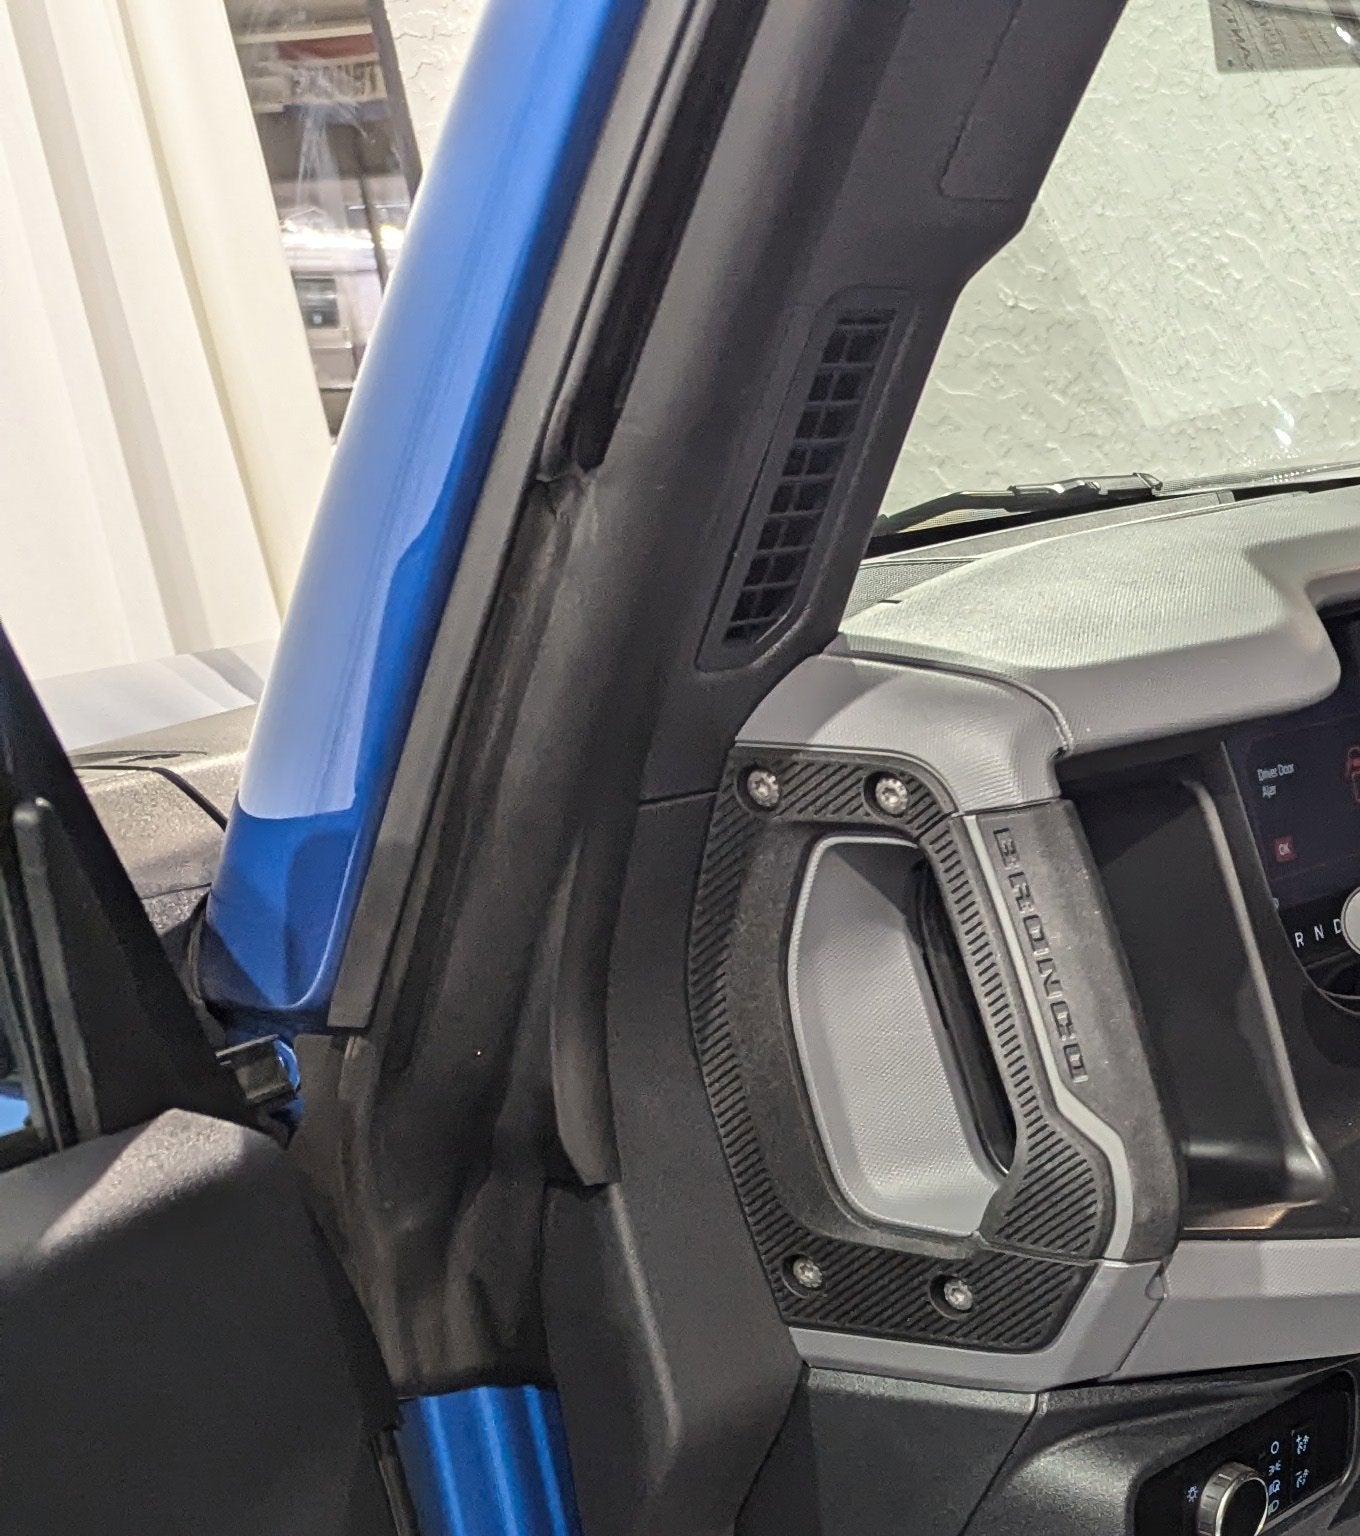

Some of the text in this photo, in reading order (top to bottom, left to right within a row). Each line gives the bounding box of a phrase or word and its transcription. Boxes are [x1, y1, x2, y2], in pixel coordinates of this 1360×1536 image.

[1278, 764, 1295, 776] Door
[1294, 931, 1305, 948] R
[1314, 924, 1325, 941] N
[993, 827, 1088, 1084] BRONCO
